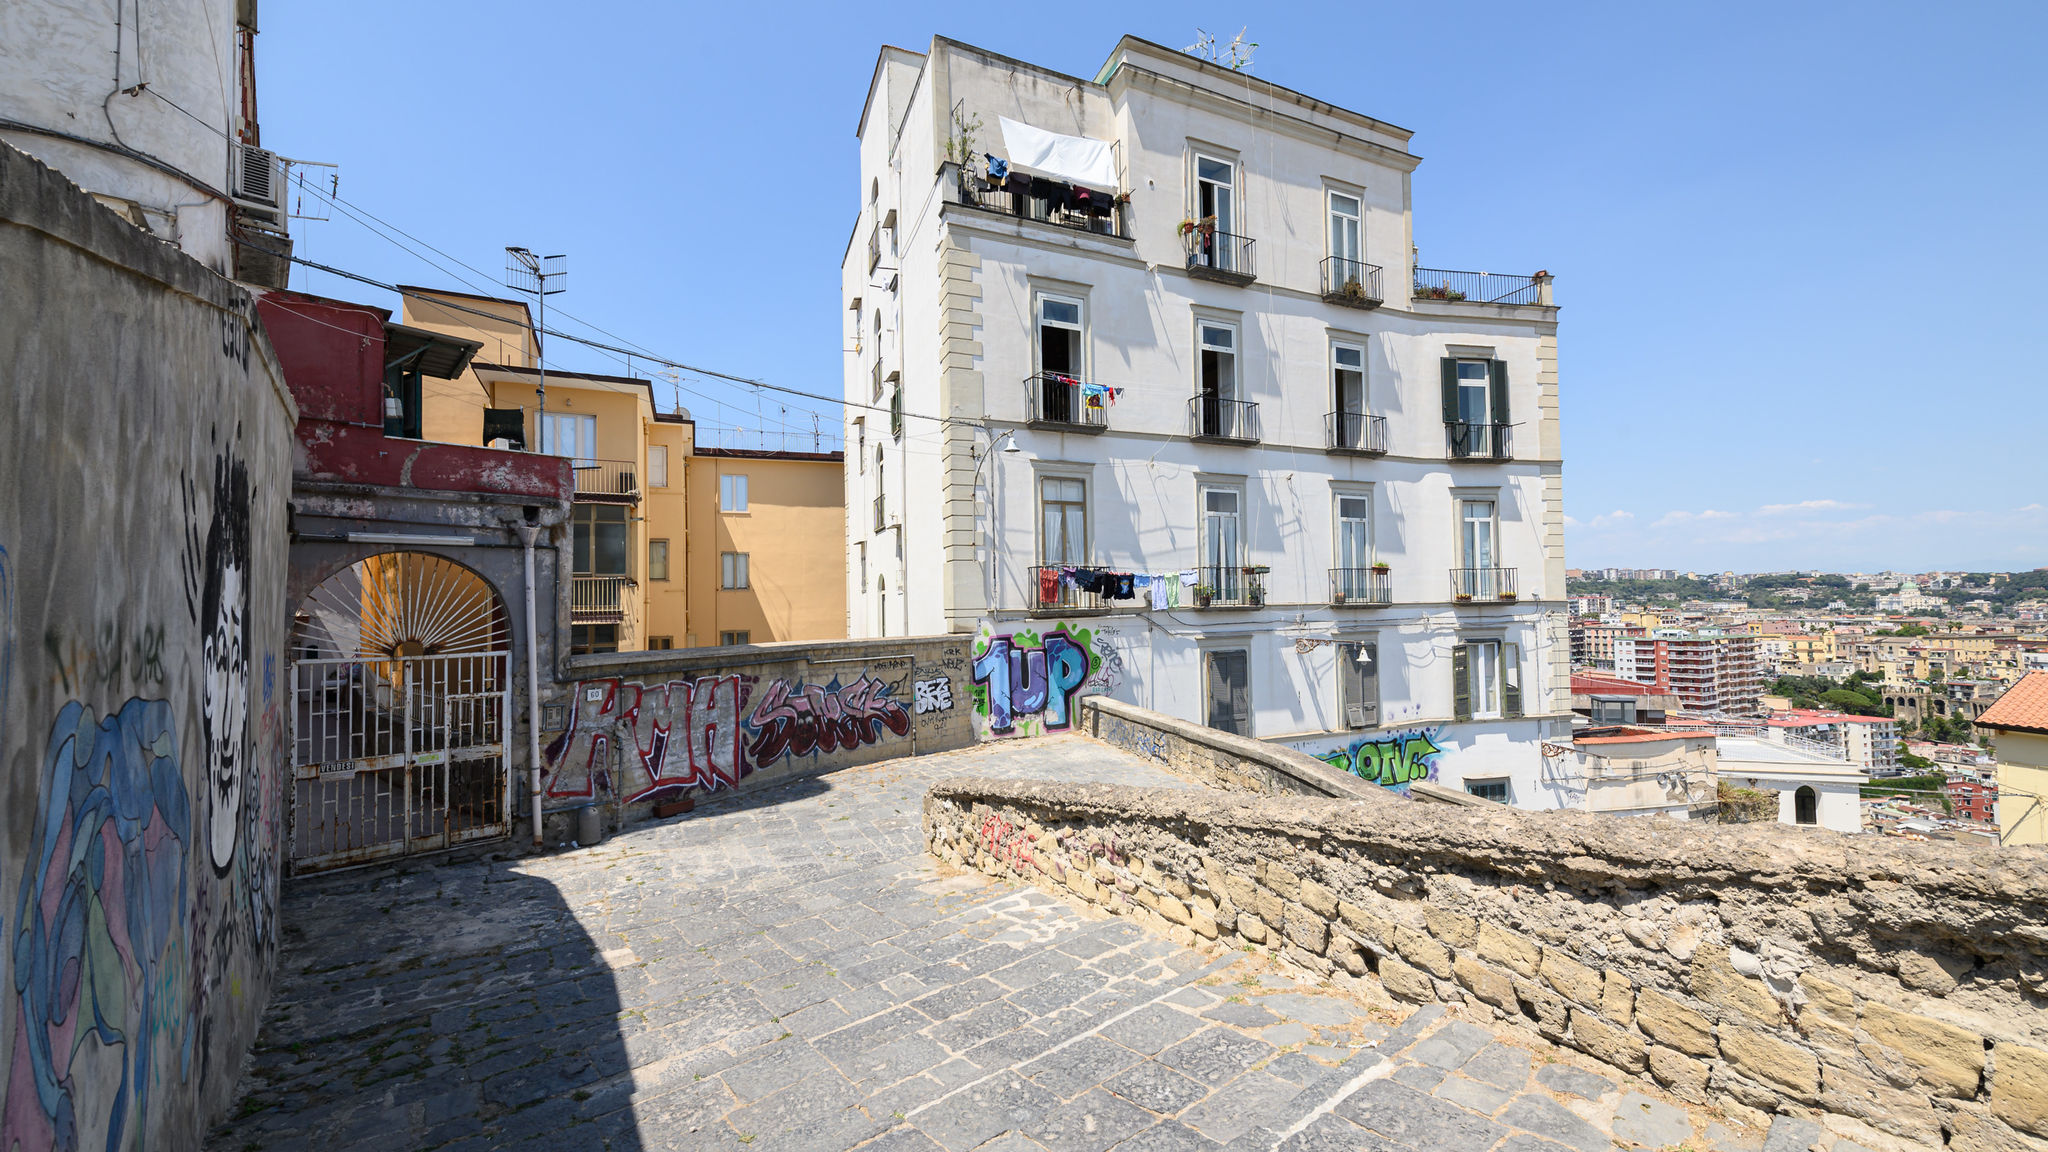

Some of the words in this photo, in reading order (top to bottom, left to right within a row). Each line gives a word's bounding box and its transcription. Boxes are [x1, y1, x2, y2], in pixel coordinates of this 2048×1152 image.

[972, 630, 1090, 737] 1UP
[590, 690, 600, 699] 60
[321, 762, 355, 773] VENDESI
